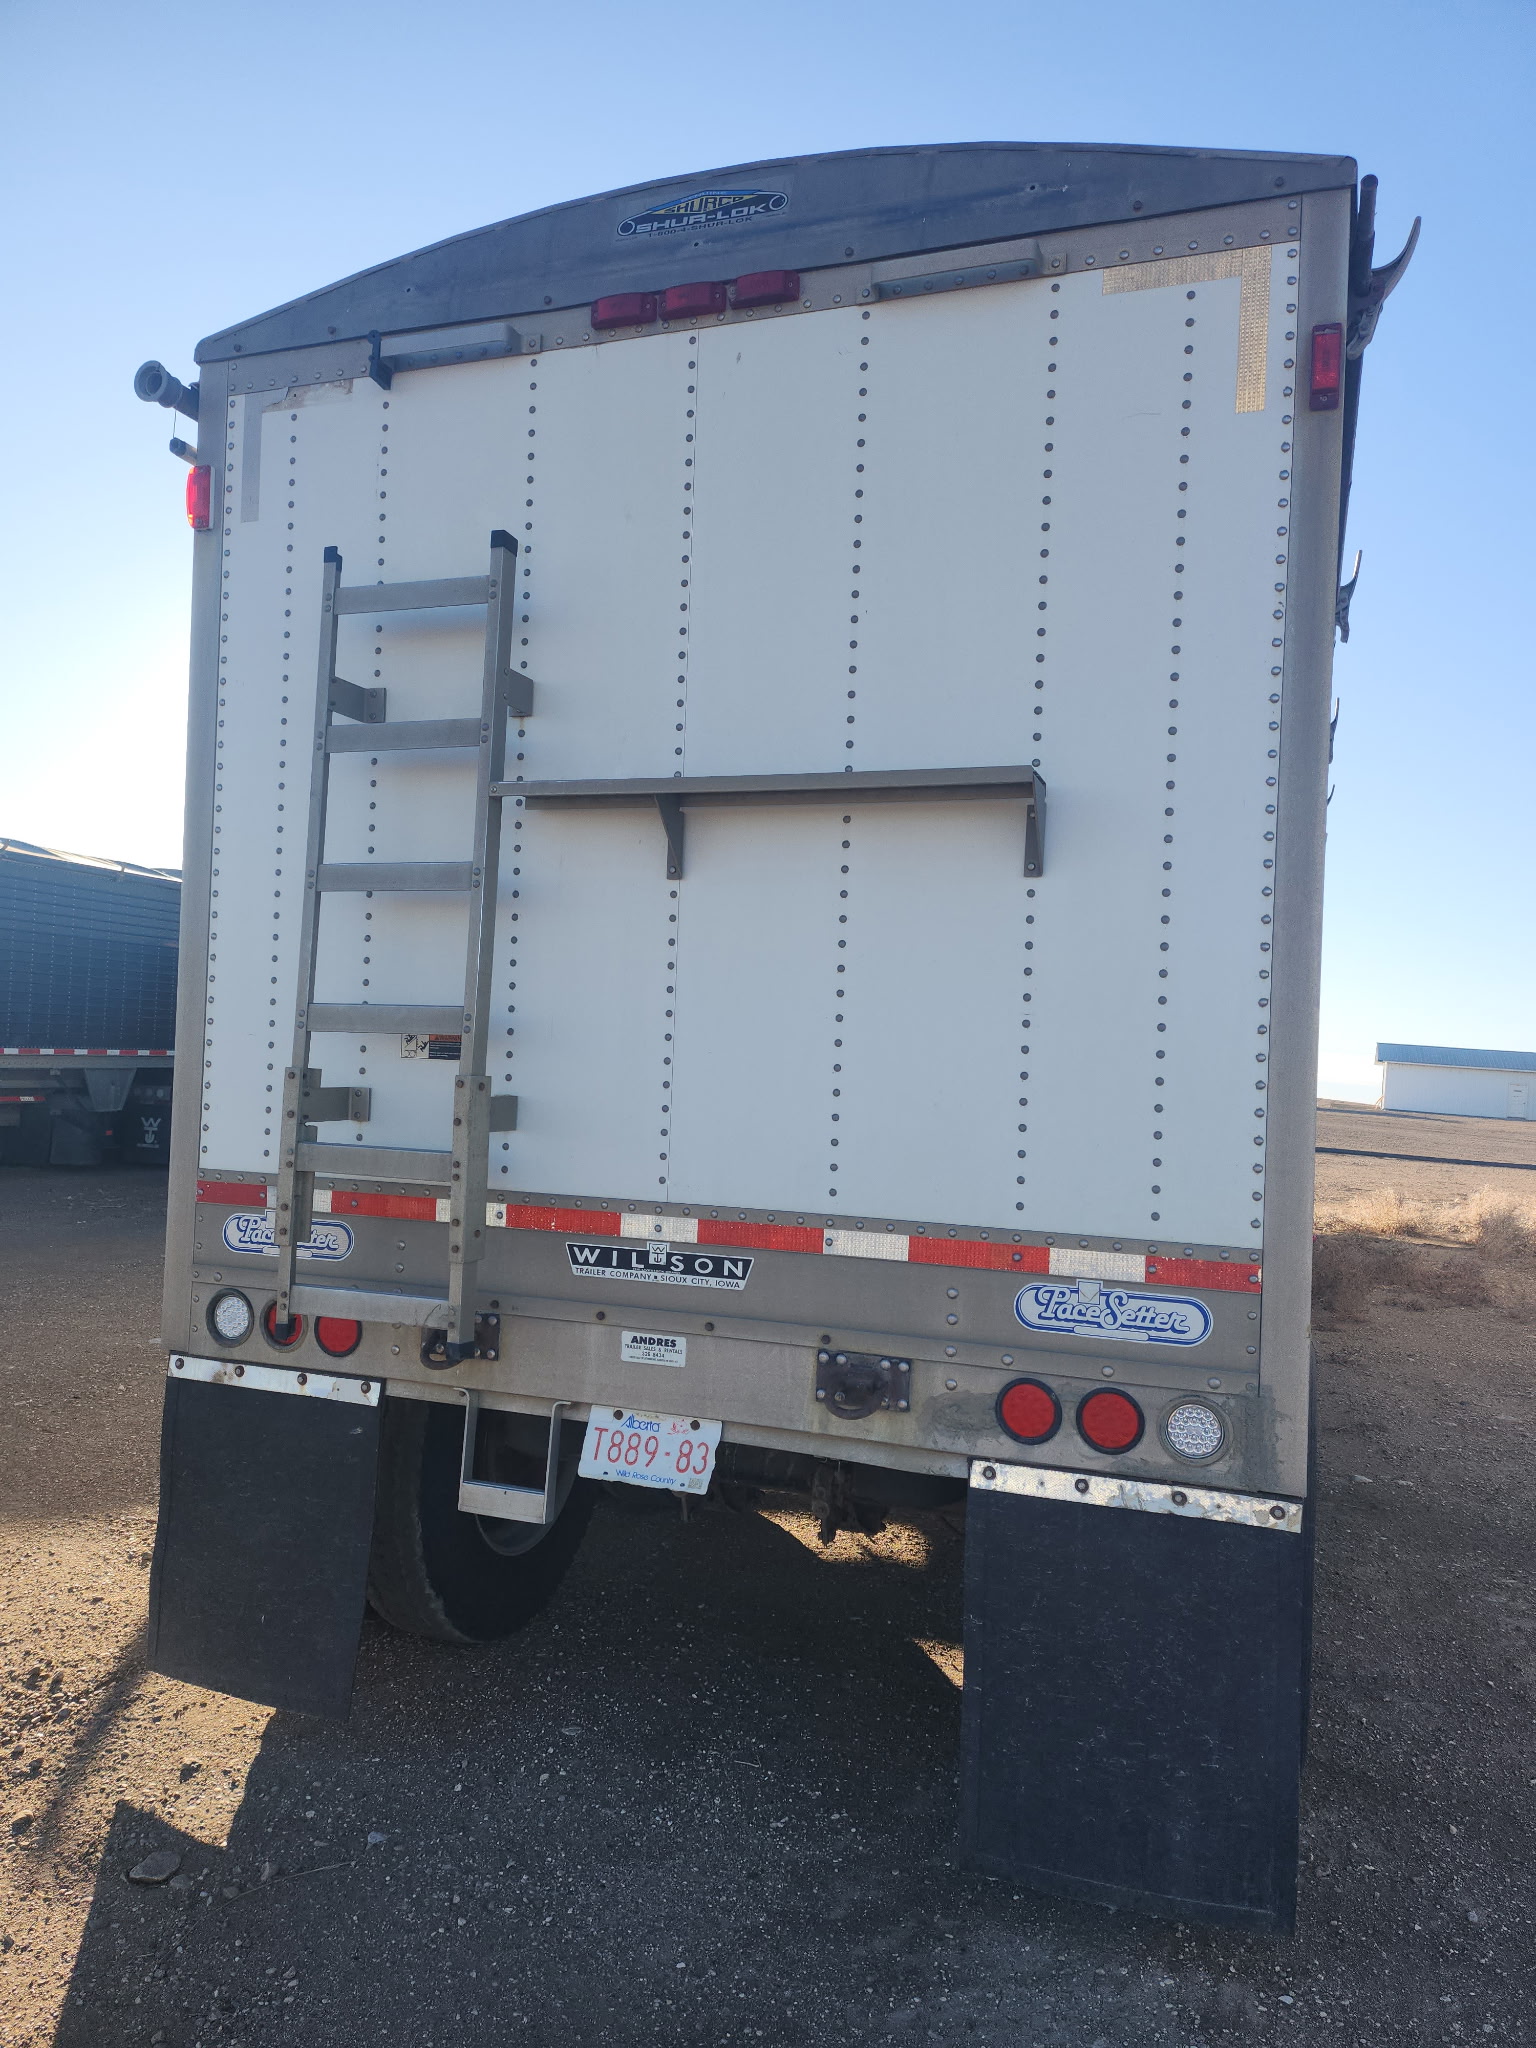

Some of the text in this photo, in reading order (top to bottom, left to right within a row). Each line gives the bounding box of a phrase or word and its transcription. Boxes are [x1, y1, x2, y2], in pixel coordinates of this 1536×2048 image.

[635, 203, 767, 234] SHUR-LOK
[573, 1246, 743, 1278] WILSON
[575, 1267, 606, 1277] TRAILER
[609, 1270, 652, 1281] COMPANY
[660, 1274, 688, 1284] SIOUX
[691, 1277, 712, 1287] CITY,
[715, 1280, 740, 1289] IOWA
[630, 1335, 677, 1348] ANDRES
[664, 1347, 683, 1355] RENTALS
[620, 1413, 661, 1433] Alberta
[593, 1426, 710, 1475] T889-83
[615, 1469, 631, 1478] Wild
[632, 1471, 649, 1481] Rose
